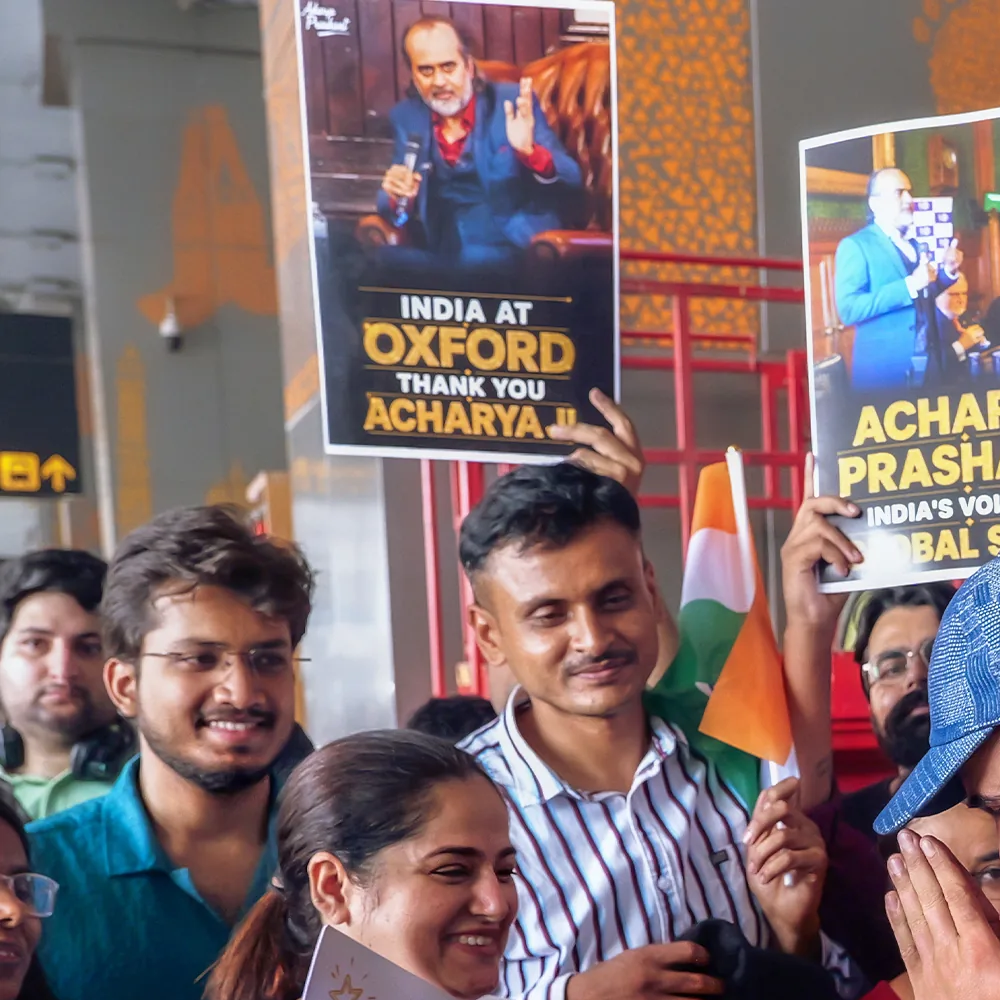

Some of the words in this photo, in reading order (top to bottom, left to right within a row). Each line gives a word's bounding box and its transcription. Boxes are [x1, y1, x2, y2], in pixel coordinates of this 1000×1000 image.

[400, 295, 486, 323] INDIA
[495, 300, 533, 325] AT
[363, 322, 576, 374] OXFORD
[396, 372, 486, 398] THANK
[491, 377, 546, 400] YOU
[363, 396, 545, 439] ACHARYA
[867, 497, 954, 527] INDIA'S
